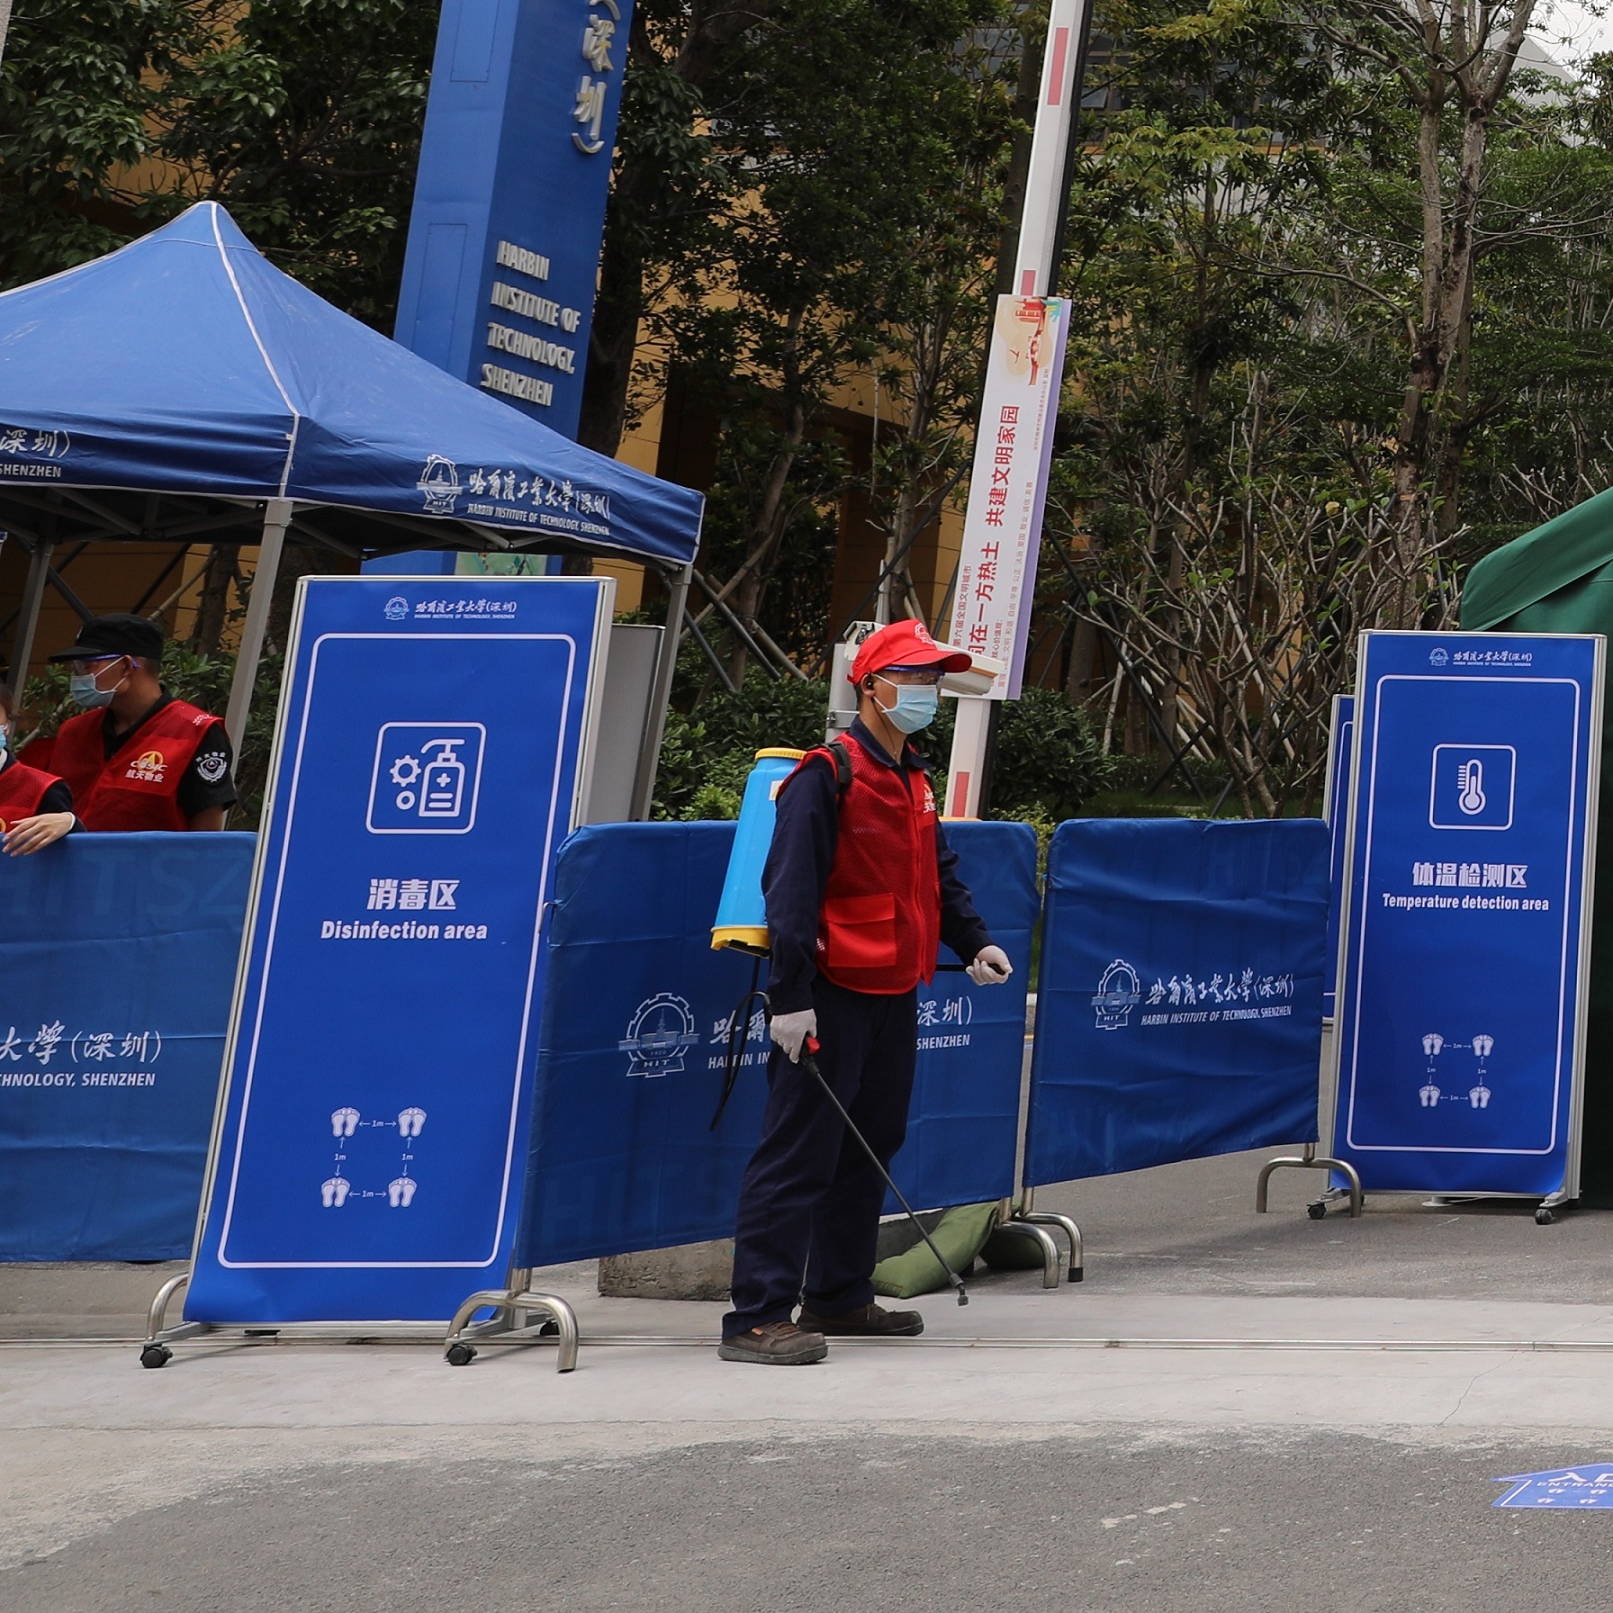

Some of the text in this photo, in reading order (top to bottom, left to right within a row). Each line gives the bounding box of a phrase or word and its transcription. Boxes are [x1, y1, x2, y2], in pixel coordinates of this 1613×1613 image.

[496, 240, 550, 281] HARBIN
[490, 281, 581, 333] INSTITUTE OF
[487, 322, 575, 374] TECHNOLOGY,
[480, 363, 553, 406] SHENZHEN
[985, 405, 1020, 527] 共建文明家园
[467, 503, 494, 515] HARBIN
[495, 507, 527, 522] INSTITUTE
[529, 512, 538, 523] OF
[1412, 862, 1528, 888] 体温检测区
[366, 878, 460, 910] 消毒区
[1382, 893, 1549, 912] Temperature detection area
[321, 920, 488, 939] Disinfection area
[1141, 1013, 1168, 1026] HARBIN
[1170, 1012, 1208, 1023] INSTITUTE
[1210, 1011, 1220, 1021] OF
[1261, 1005, 1292, 1018] SHENZHEN
[917, 1034, 970, 1051] SHENZHEN
[643, 1058, 668, 1067] HIT
[82, 1073, 155, 1087] SHENZHEN
